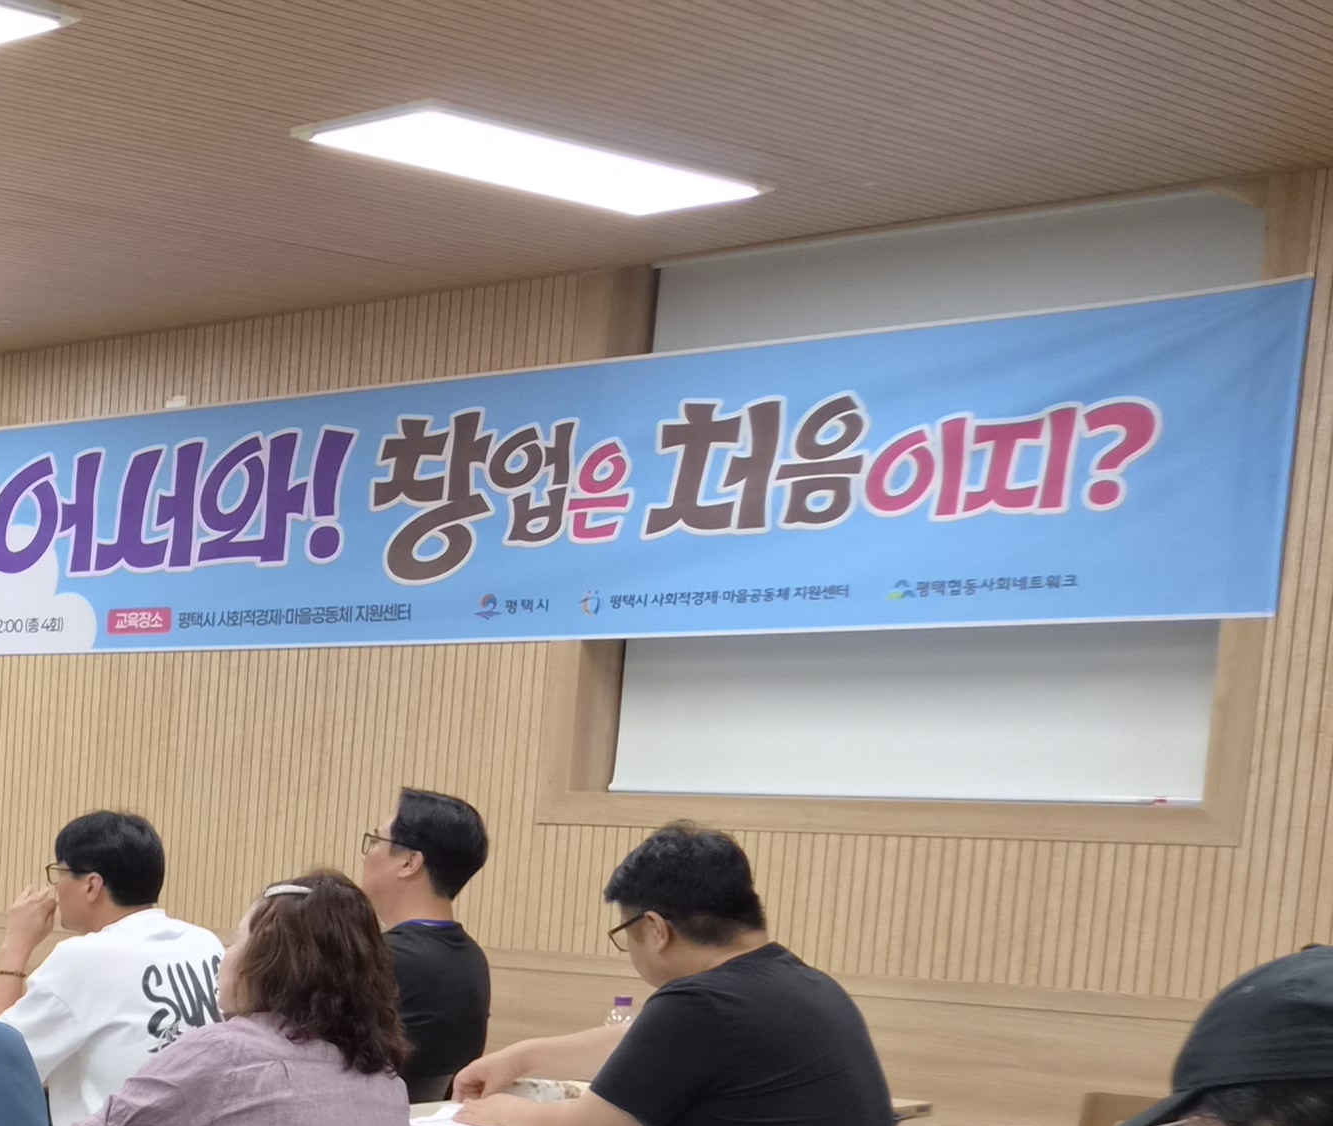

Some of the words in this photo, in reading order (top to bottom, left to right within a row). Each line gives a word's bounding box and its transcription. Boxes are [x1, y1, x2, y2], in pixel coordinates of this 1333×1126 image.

[374, 411, 630, 581] 창업은
[645, 395, 1156, 536] 처음이지?
[610, 592, 648, 609] 평택시
[793, 583, 851, 600] 지원센터
[916, 574, 1078, 598] 평택협동사회네트워크
[178, 611, 215, 629] 평택시
[356, 603, 412, 623] 지원센터
[505, 597, 550, 614] 평택시
[114, 611, 163, 630] 교육장소
